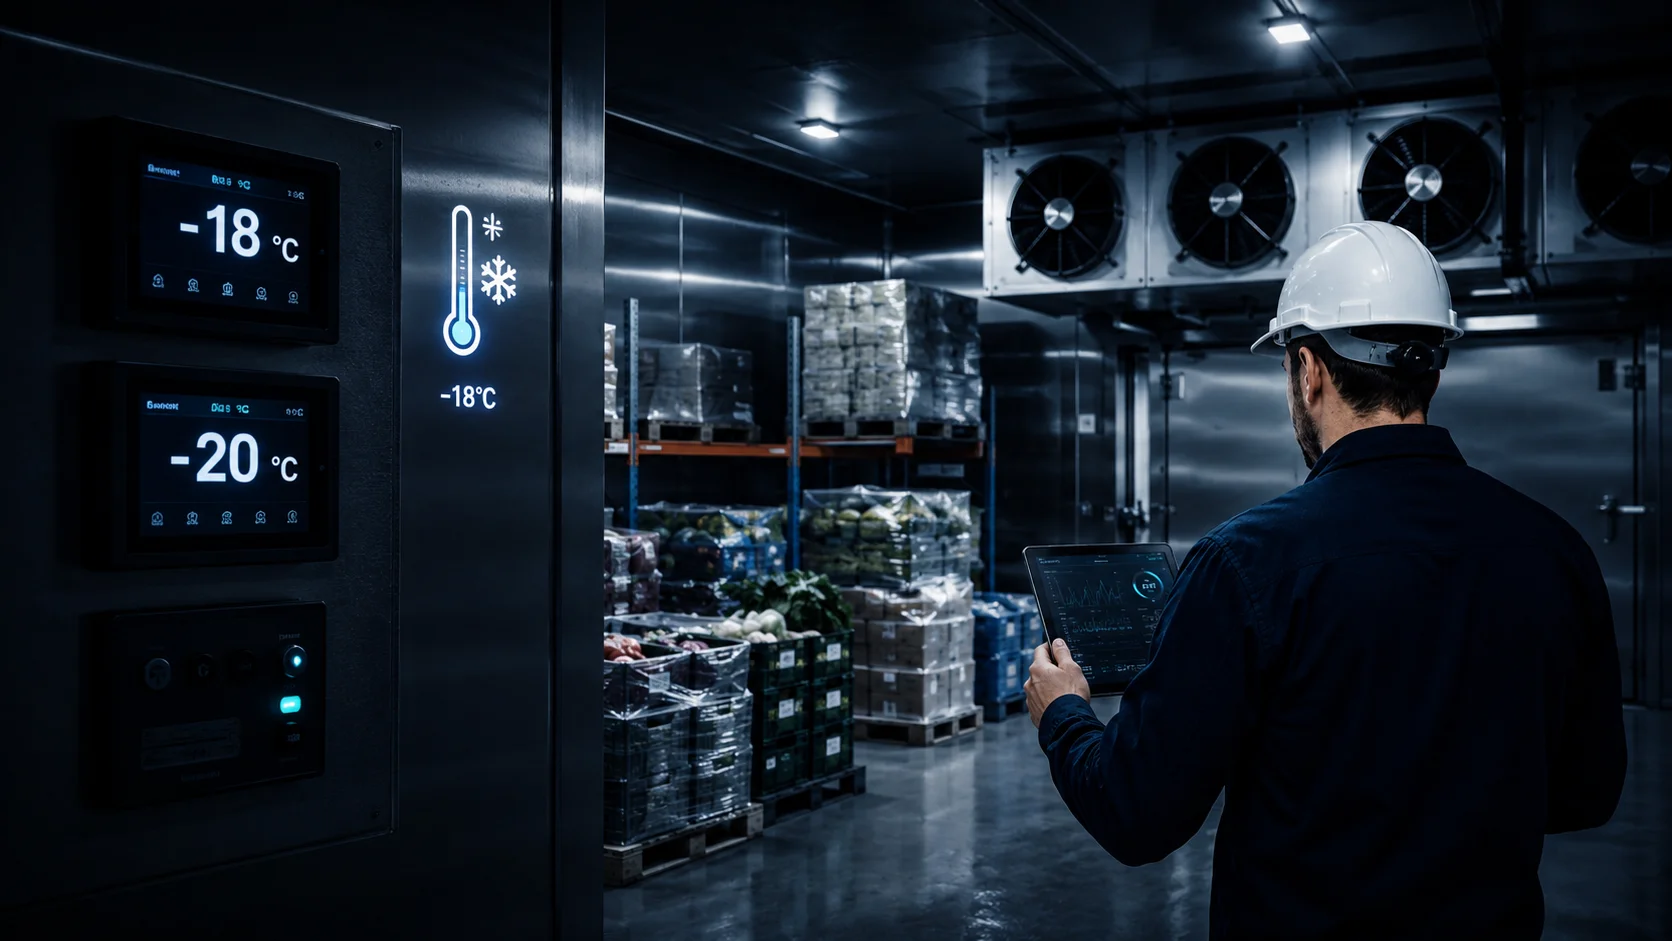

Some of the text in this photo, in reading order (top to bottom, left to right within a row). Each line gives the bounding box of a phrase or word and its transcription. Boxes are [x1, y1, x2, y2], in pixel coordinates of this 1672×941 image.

[179, 204, 299, 263] -18 °C
[440, 384, 497, 411] -18°C
[170, 431, 298, 483] -20 °C
